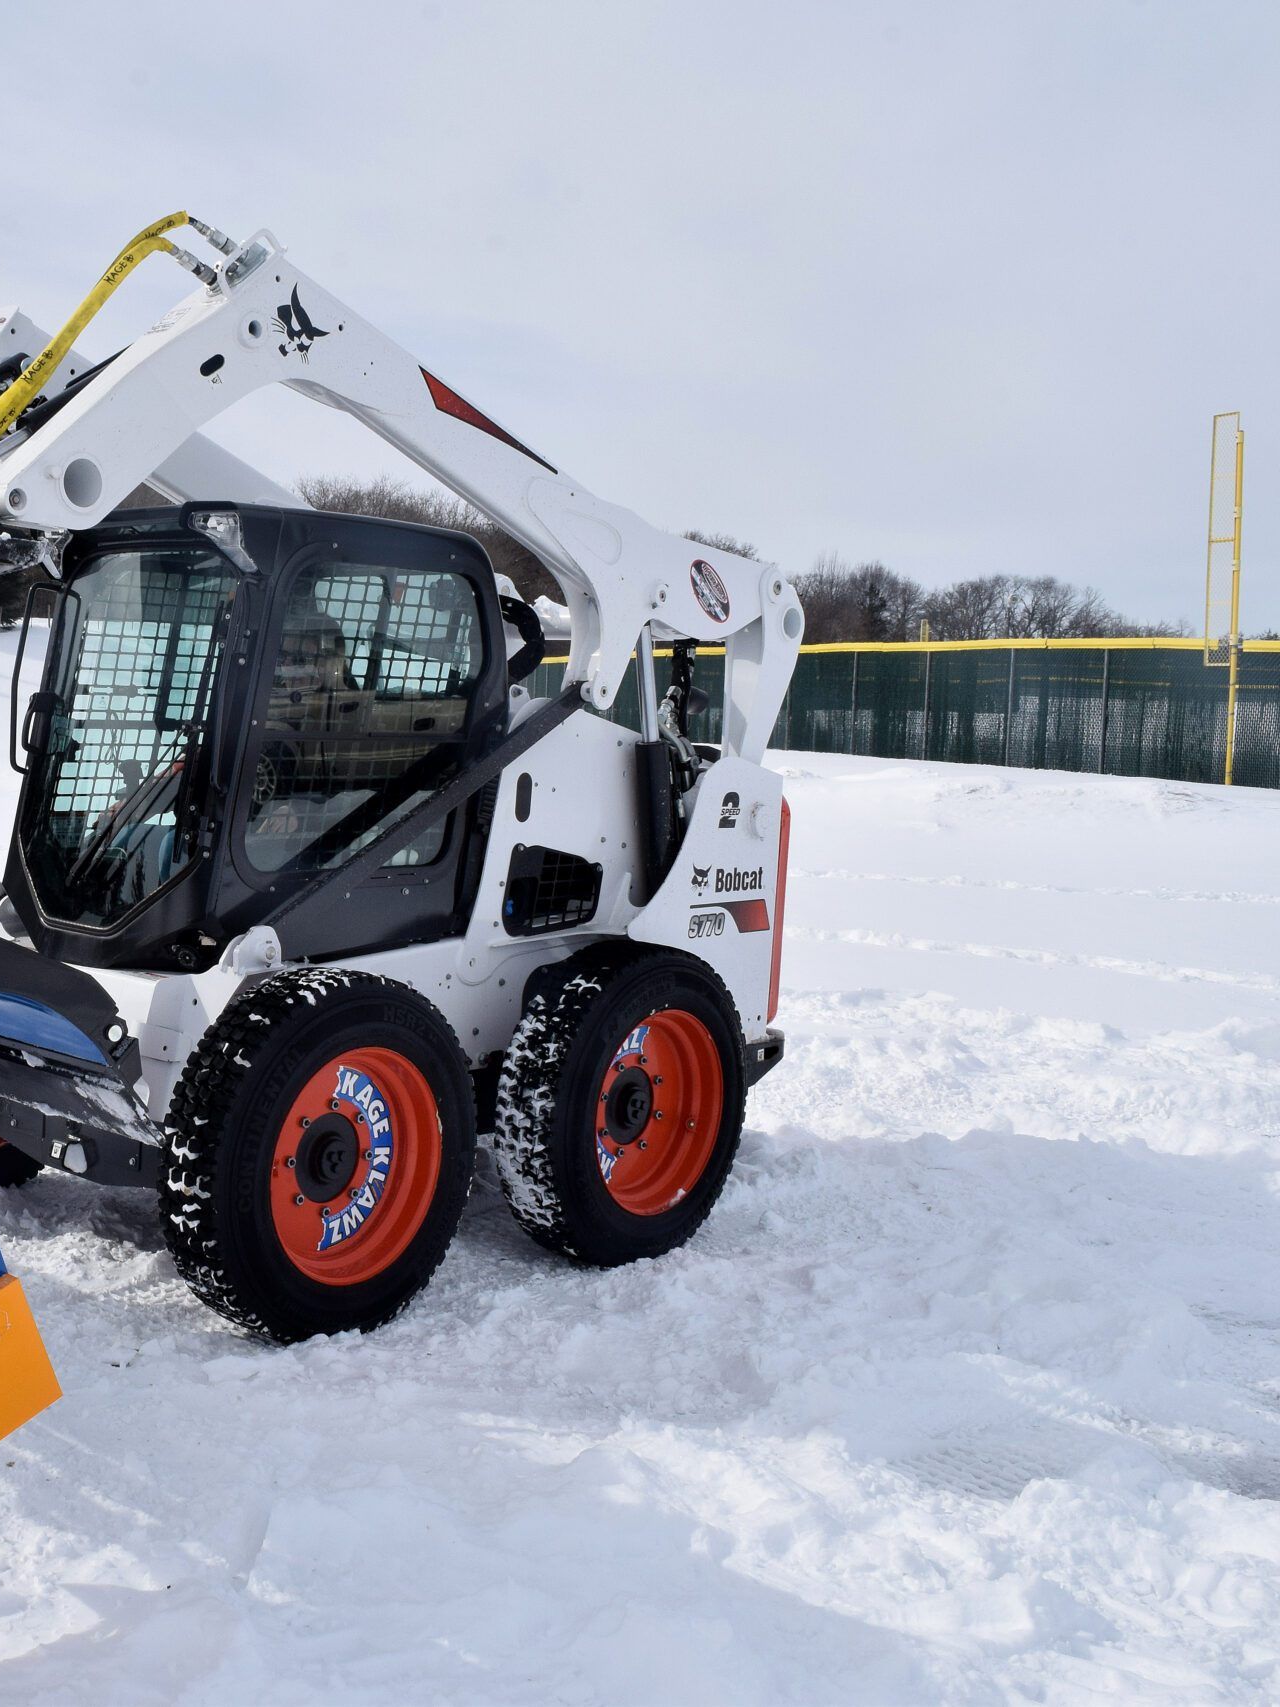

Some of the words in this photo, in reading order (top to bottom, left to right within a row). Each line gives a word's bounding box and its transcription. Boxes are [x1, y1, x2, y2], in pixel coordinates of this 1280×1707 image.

[104, 261, 128, 286] KAGE
[21, 359, 46, 384] KAGE
[720, 808, 741, 816] SPEED
[715, 866, 763, 893] Bobcat
[688, 912, 726, 939] S770
[341, 1071, 390, 1139] KAGE
[237, 1044, 306, 1213] CONTINENTAL
[328, 1146, 391, 1244] KLAWZ
